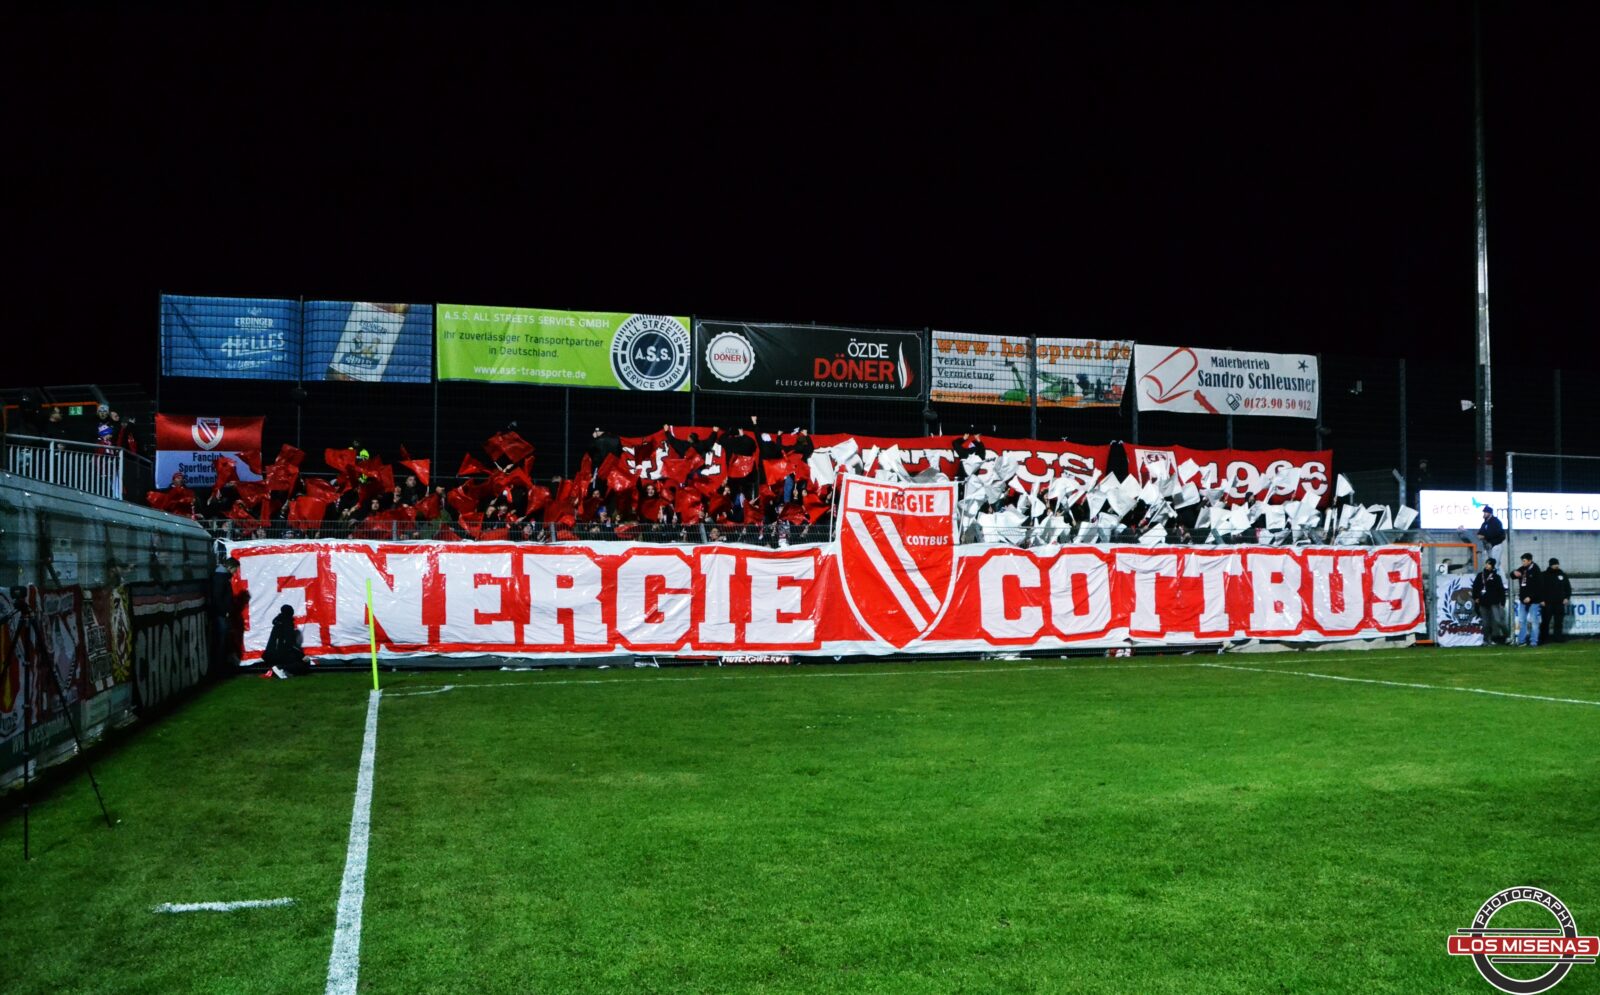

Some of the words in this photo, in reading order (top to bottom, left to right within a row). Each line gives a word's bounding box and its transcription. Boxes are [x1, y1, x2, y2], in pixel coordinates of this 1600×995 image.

[444, 312, 470, 322] A.S.S.
[473, 313, 490, 323] ALL
[493, 314, 535, 325] STREETS
[538, 316, 575, 327] SERVICE
[578, 318, 610, 329] GMBH
[443, 330, 456, 340] Ihr
[459, 331, 521, 344] zuverlässiger
[524, 334, 603, 348] Transportpartner
[625, 325, 640, 342] ALL
[642, 320, 681, 344] STREETS
[488, 346, 497, 355] in
[500, 346, 559, 358] Deutschland.
[635, 346, 671, 362] A.S.S.
[848, 338, 889, 359] ÖZDE
[814, 353, 895, 382] DÖNER
[937, 356, 977, 367] Verkauf
[1211, 356, 1270, 370] Malerbetrieb
[473, 365, 587, 380] www.ass-transporte.de
[624, 366, 655, 389] SERVICE
[659, 368, 681, 388] GMBH
[937, 367, 995, 381] Vermietung
[775, 379, 869, 390] FLEISCHPRODUKTIONS
[936, 379, 974, 389] Service
[1198, 370, 1244, 389] Sandro
[1248, 373, 1316, 393] Schleusner
[864, 489, 935, 513] ENERGIE
[906, 535, 949, 546] COTTBUS
[239, 550, 815, 652] ENERGIE
[978, 551, 1420, 638] COTTBUS
